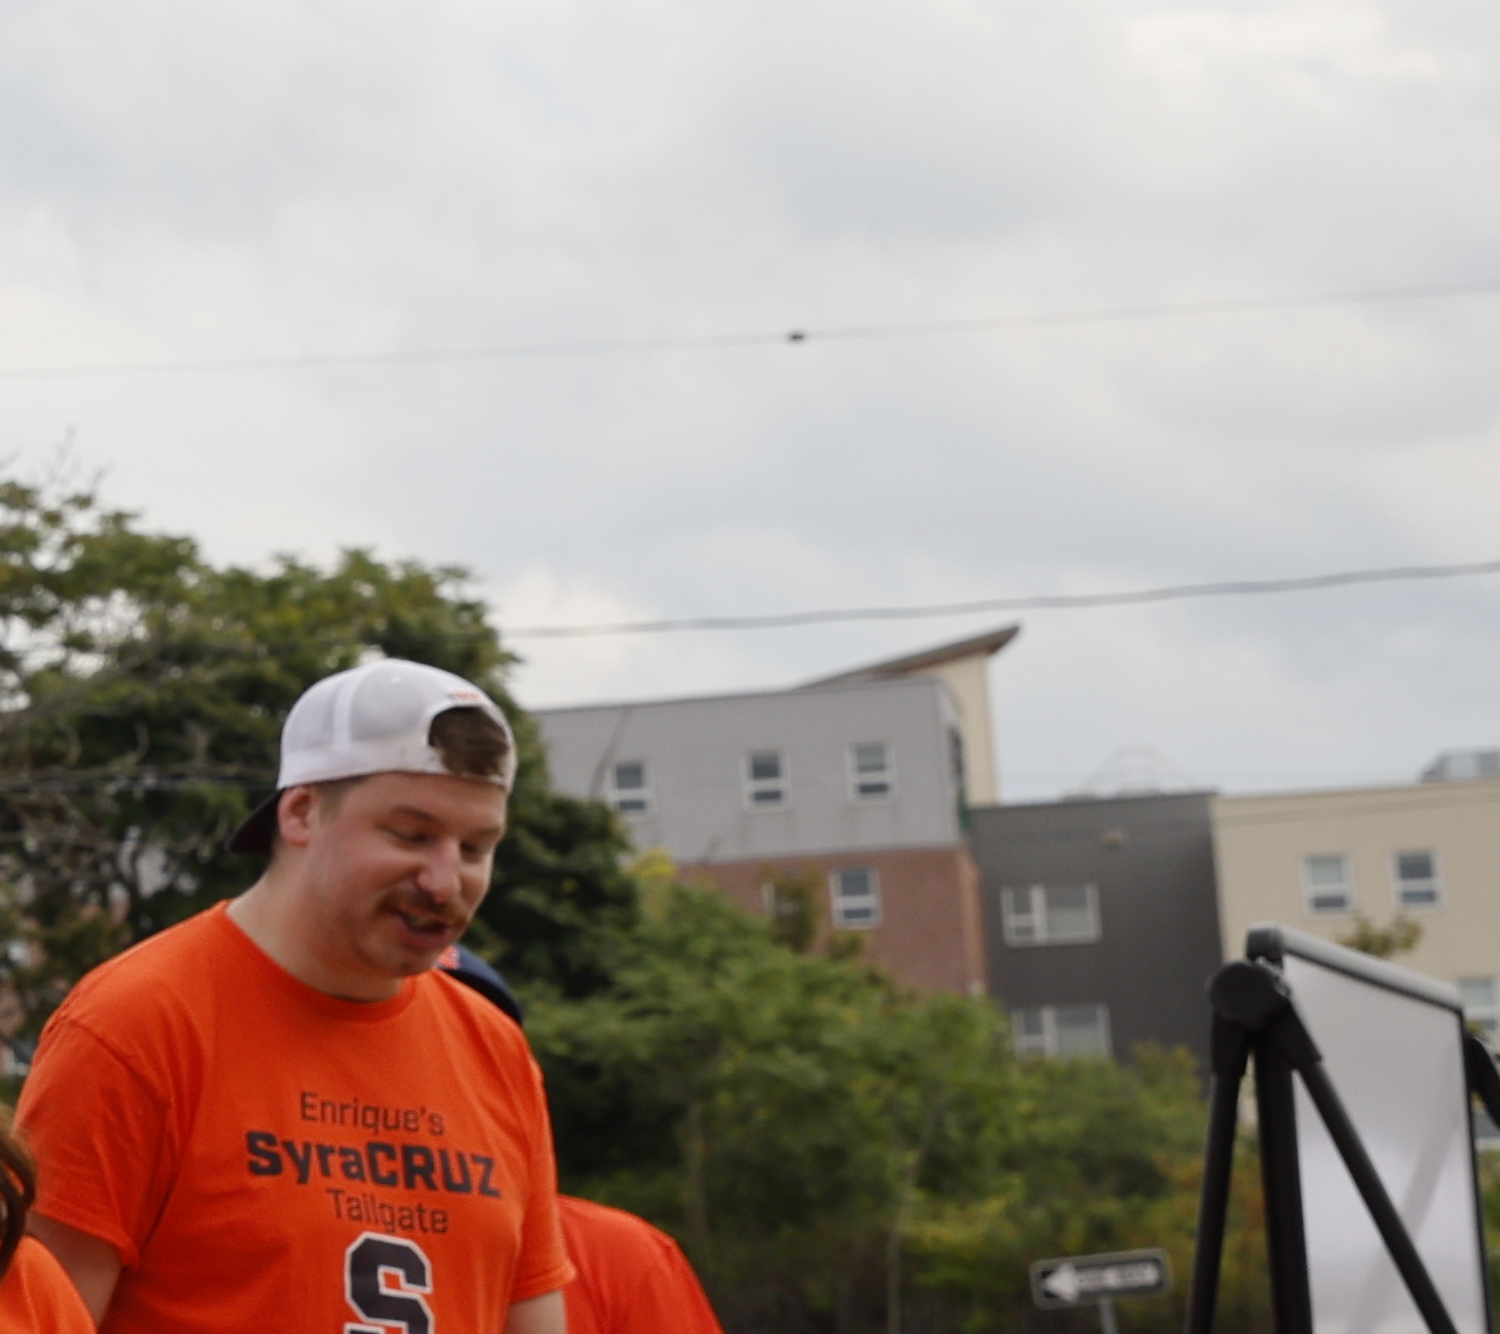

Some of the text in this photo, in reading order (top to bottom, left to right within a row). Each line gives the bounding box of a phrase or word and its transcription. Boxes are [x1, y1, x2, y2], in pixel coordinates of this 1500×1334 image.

[301, 1091, 445, 1135] Enrique's
[246, 1131, 502, 1199] SyraCRUZ
[326, 1187, 449, 1235] Tailgate
